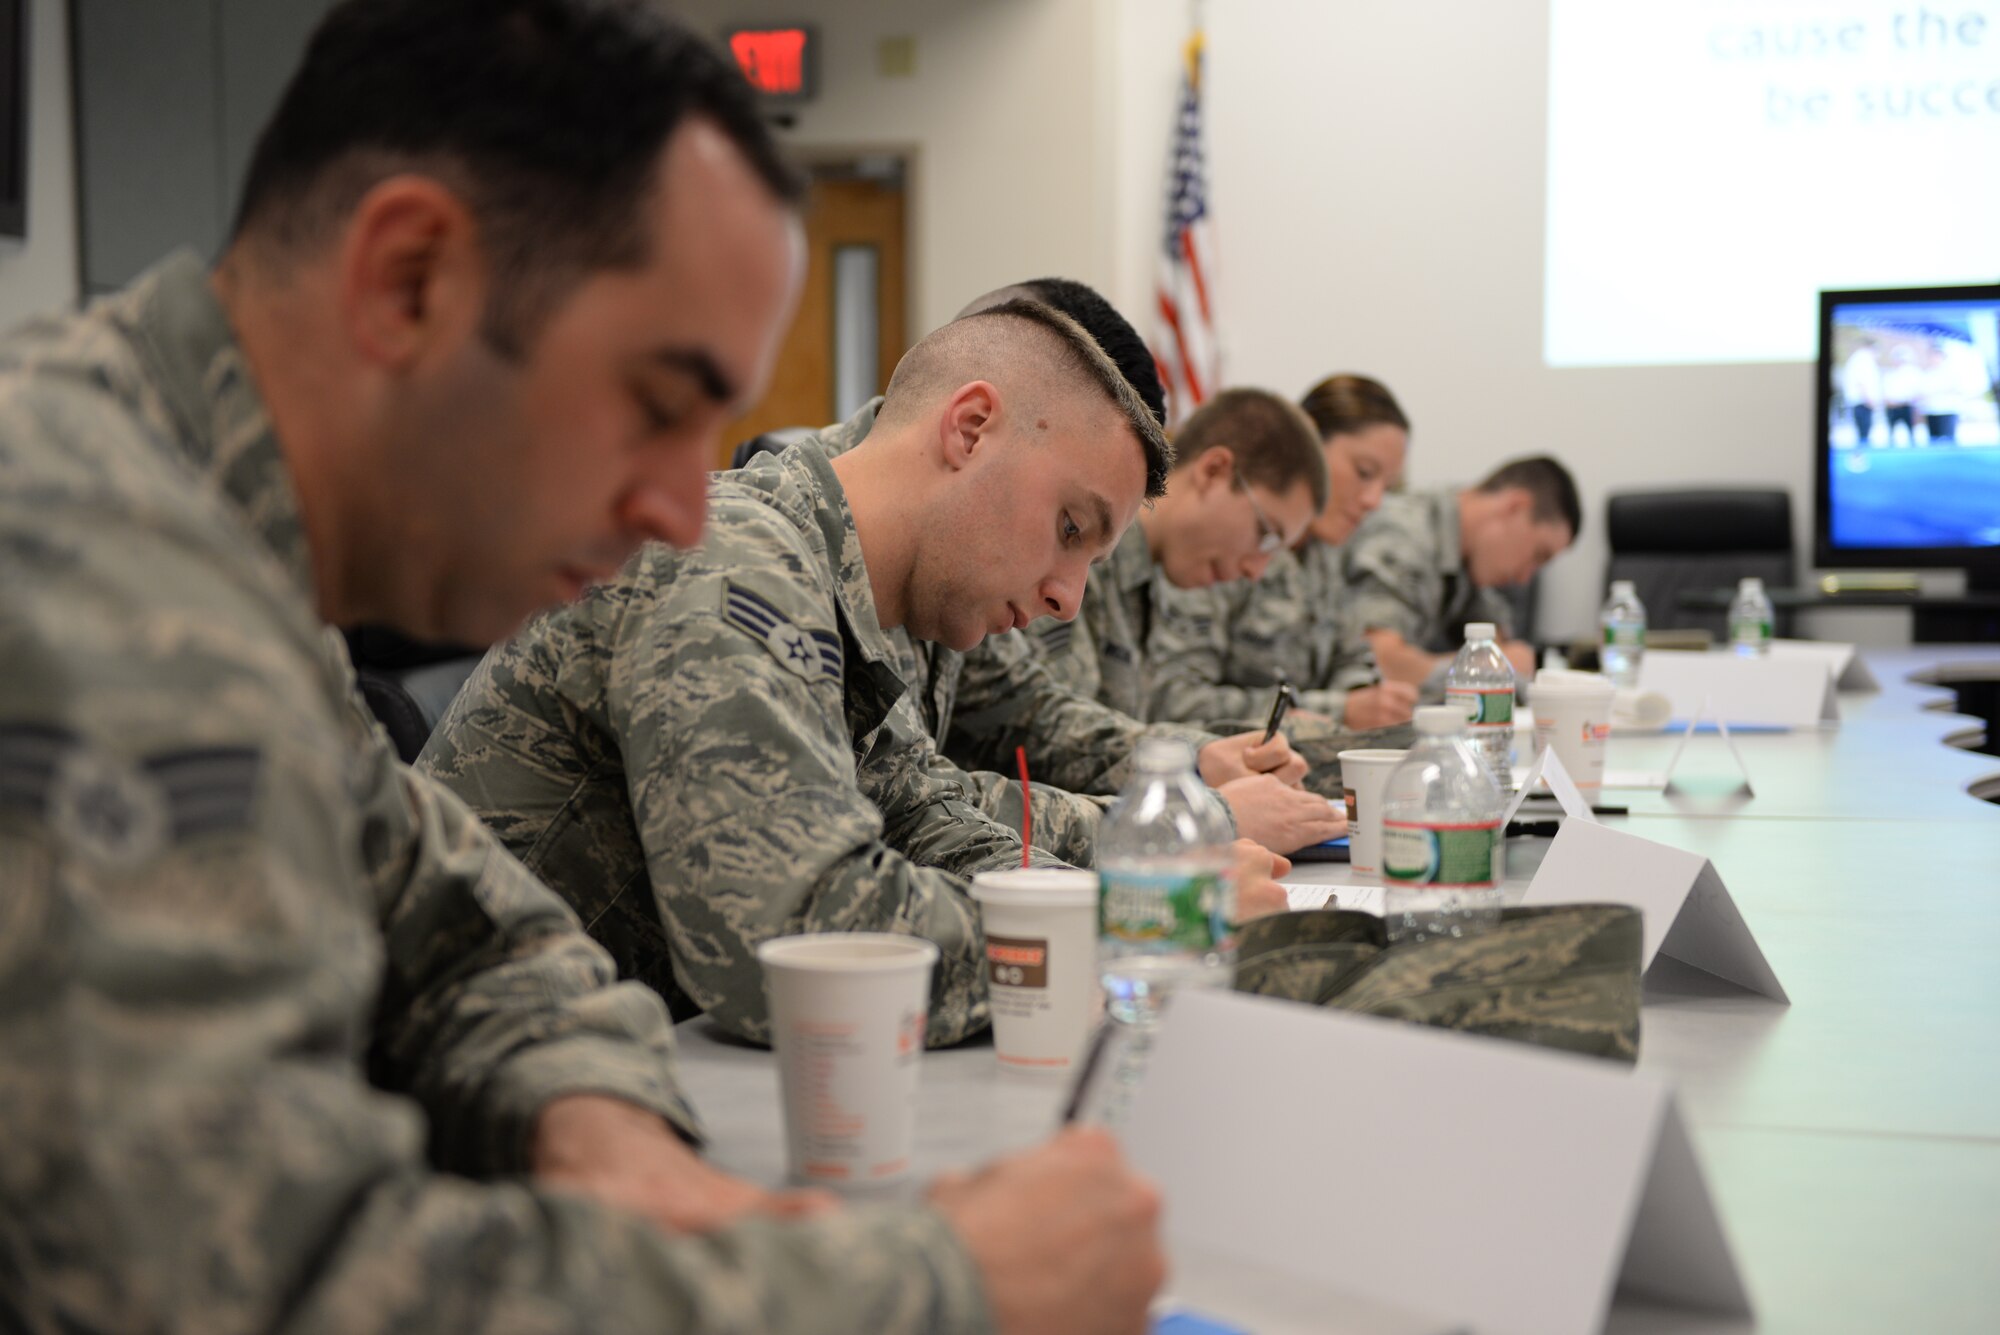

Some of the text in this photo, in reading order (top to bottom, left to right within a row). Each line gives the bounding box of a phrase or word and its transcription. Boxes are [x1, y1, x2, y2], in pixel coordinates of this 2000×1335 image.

[1706, 5, 1987, 59] cause the
[1763, 82, 1833, 123] be
